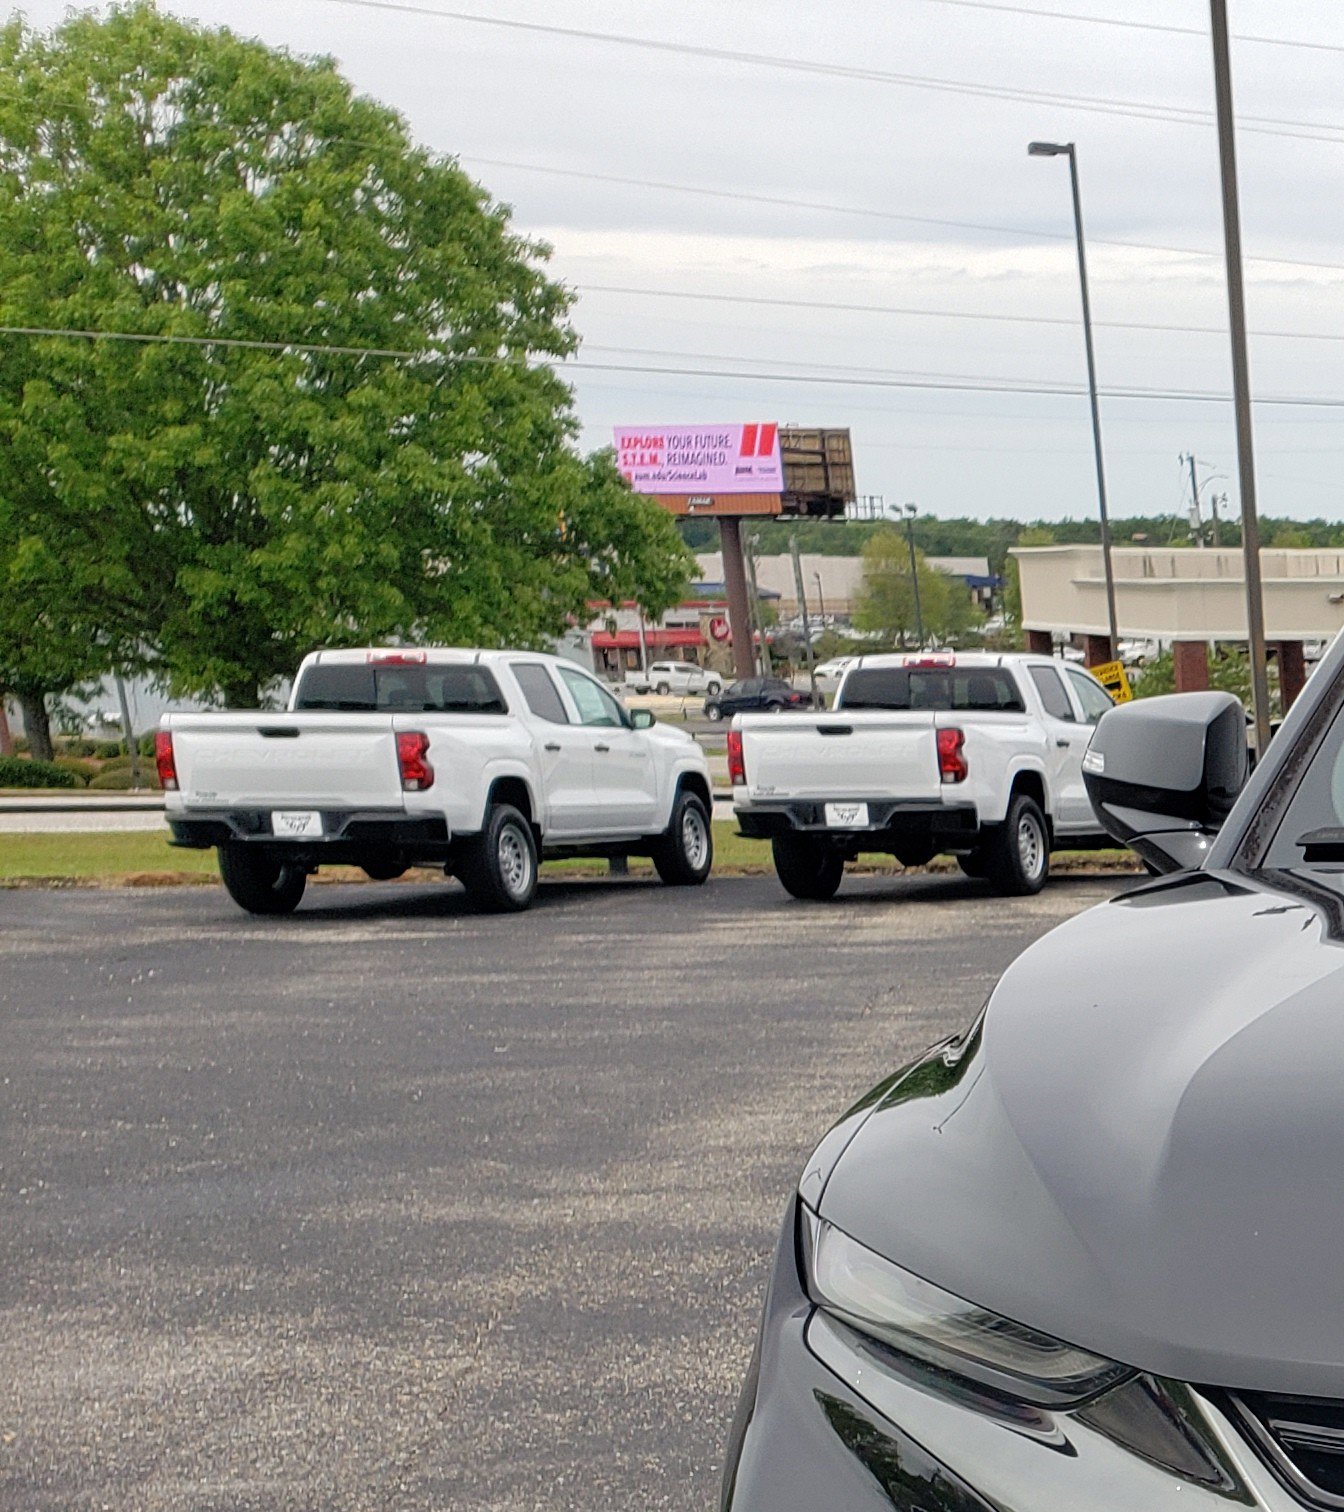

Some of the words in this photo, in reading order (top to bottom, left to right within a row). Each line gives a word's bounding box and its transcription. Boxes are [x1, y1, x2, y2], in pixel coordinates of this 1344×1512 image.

[621, 435, 664, 449] EXPLORE
[667, 434, 692, 449] YOUR
[694, 433, 732, 448] FUTURE.
[667, 452, 727, 466] REIMAGINED.
